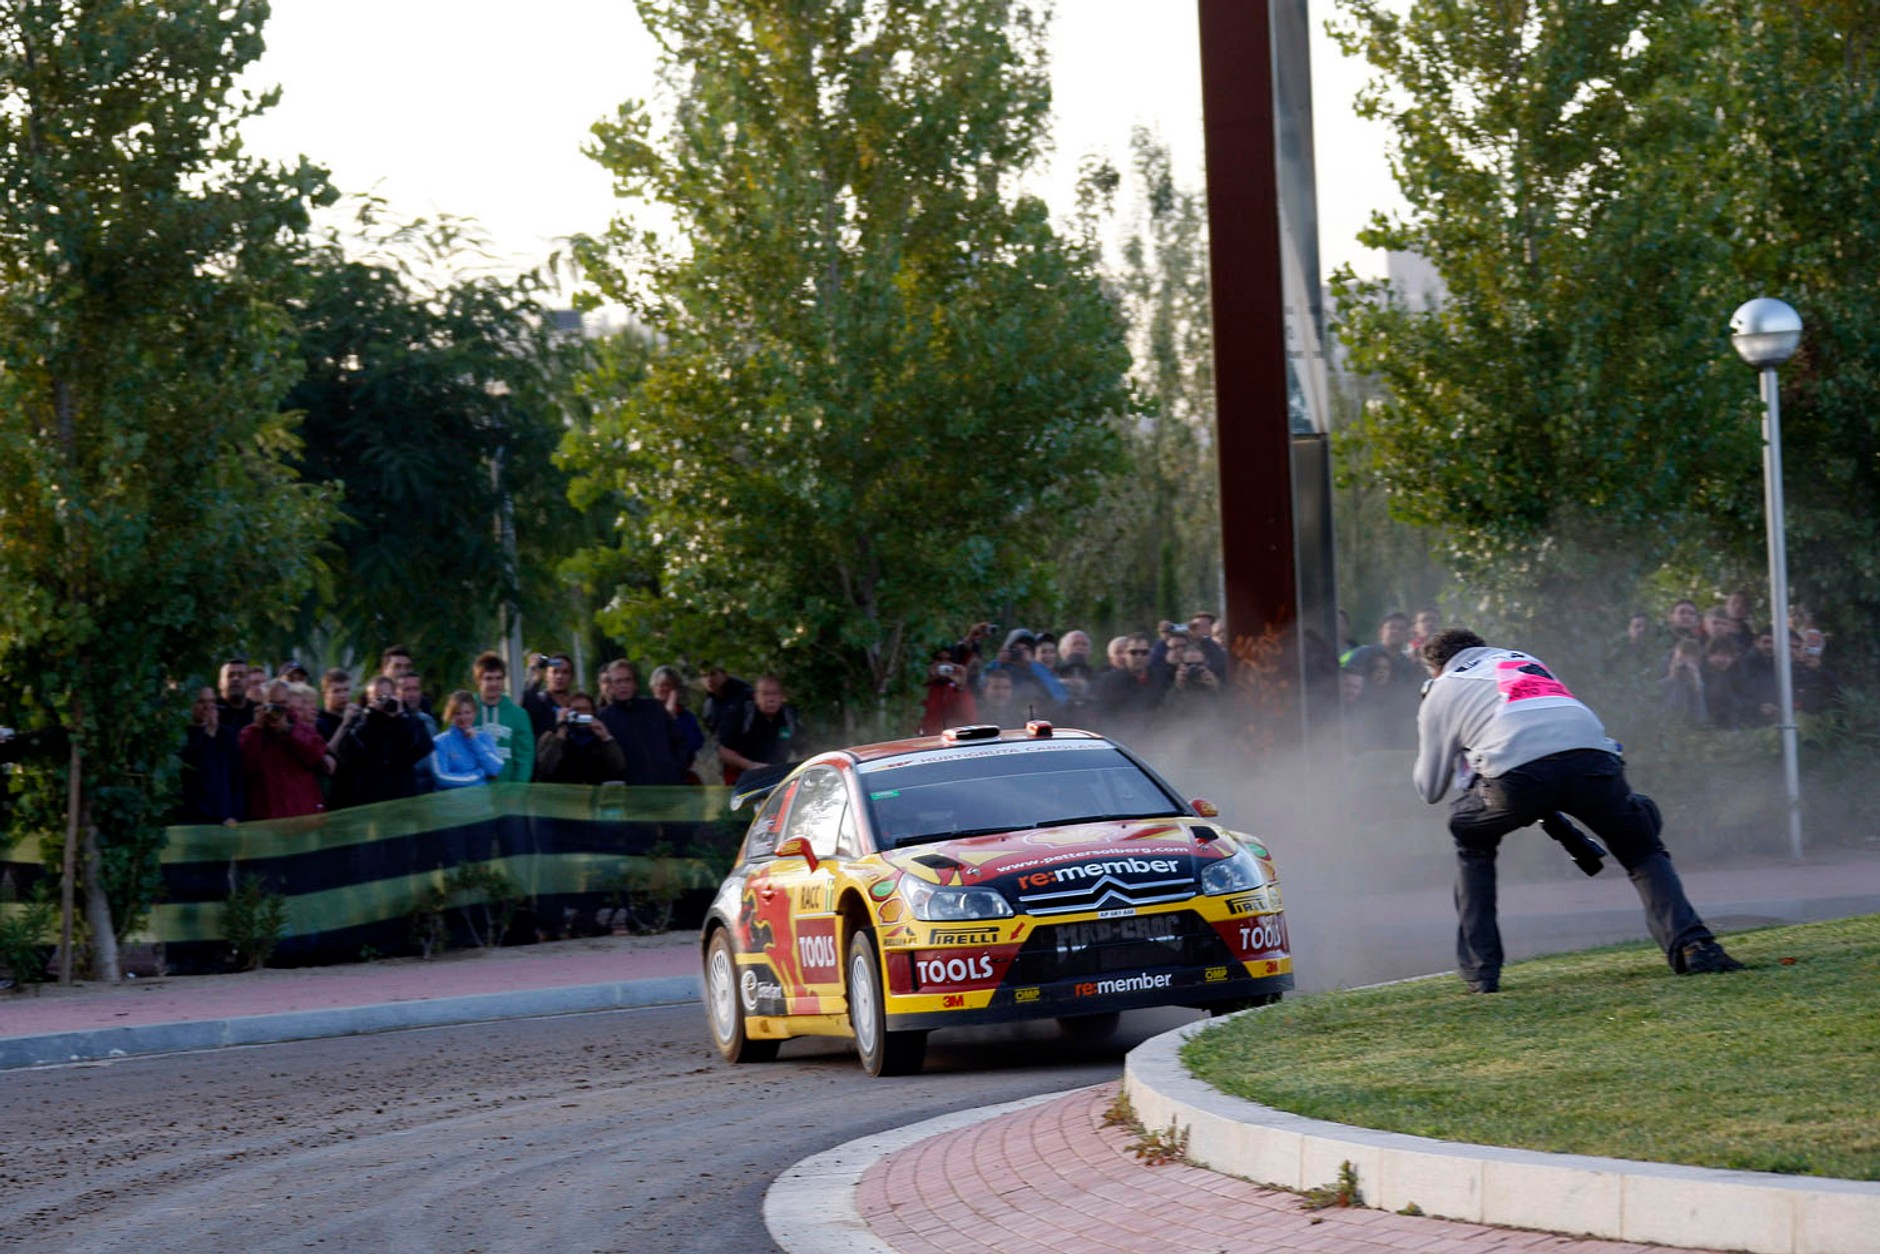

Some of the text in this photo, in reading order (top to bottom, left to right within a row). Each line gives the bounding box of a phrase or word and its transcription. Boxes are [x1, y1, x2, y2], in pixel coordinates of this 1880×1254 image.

[996, 846, 1189, 872] www.pettersolberg.com
[1018, 858, 1179, 890] re:member
[929, 927, 1000, 945] PIRELLI
[799, 935, 836, 968] TOOLS
[917, 956, 994, 984] TOOLS
[1205, 968, 1228, 980] OMP
[1014, 988, 1040, 1000] OMP
[1075, 973, 1172, 997] re:member
[943, 995, 965, 1009] 3M
